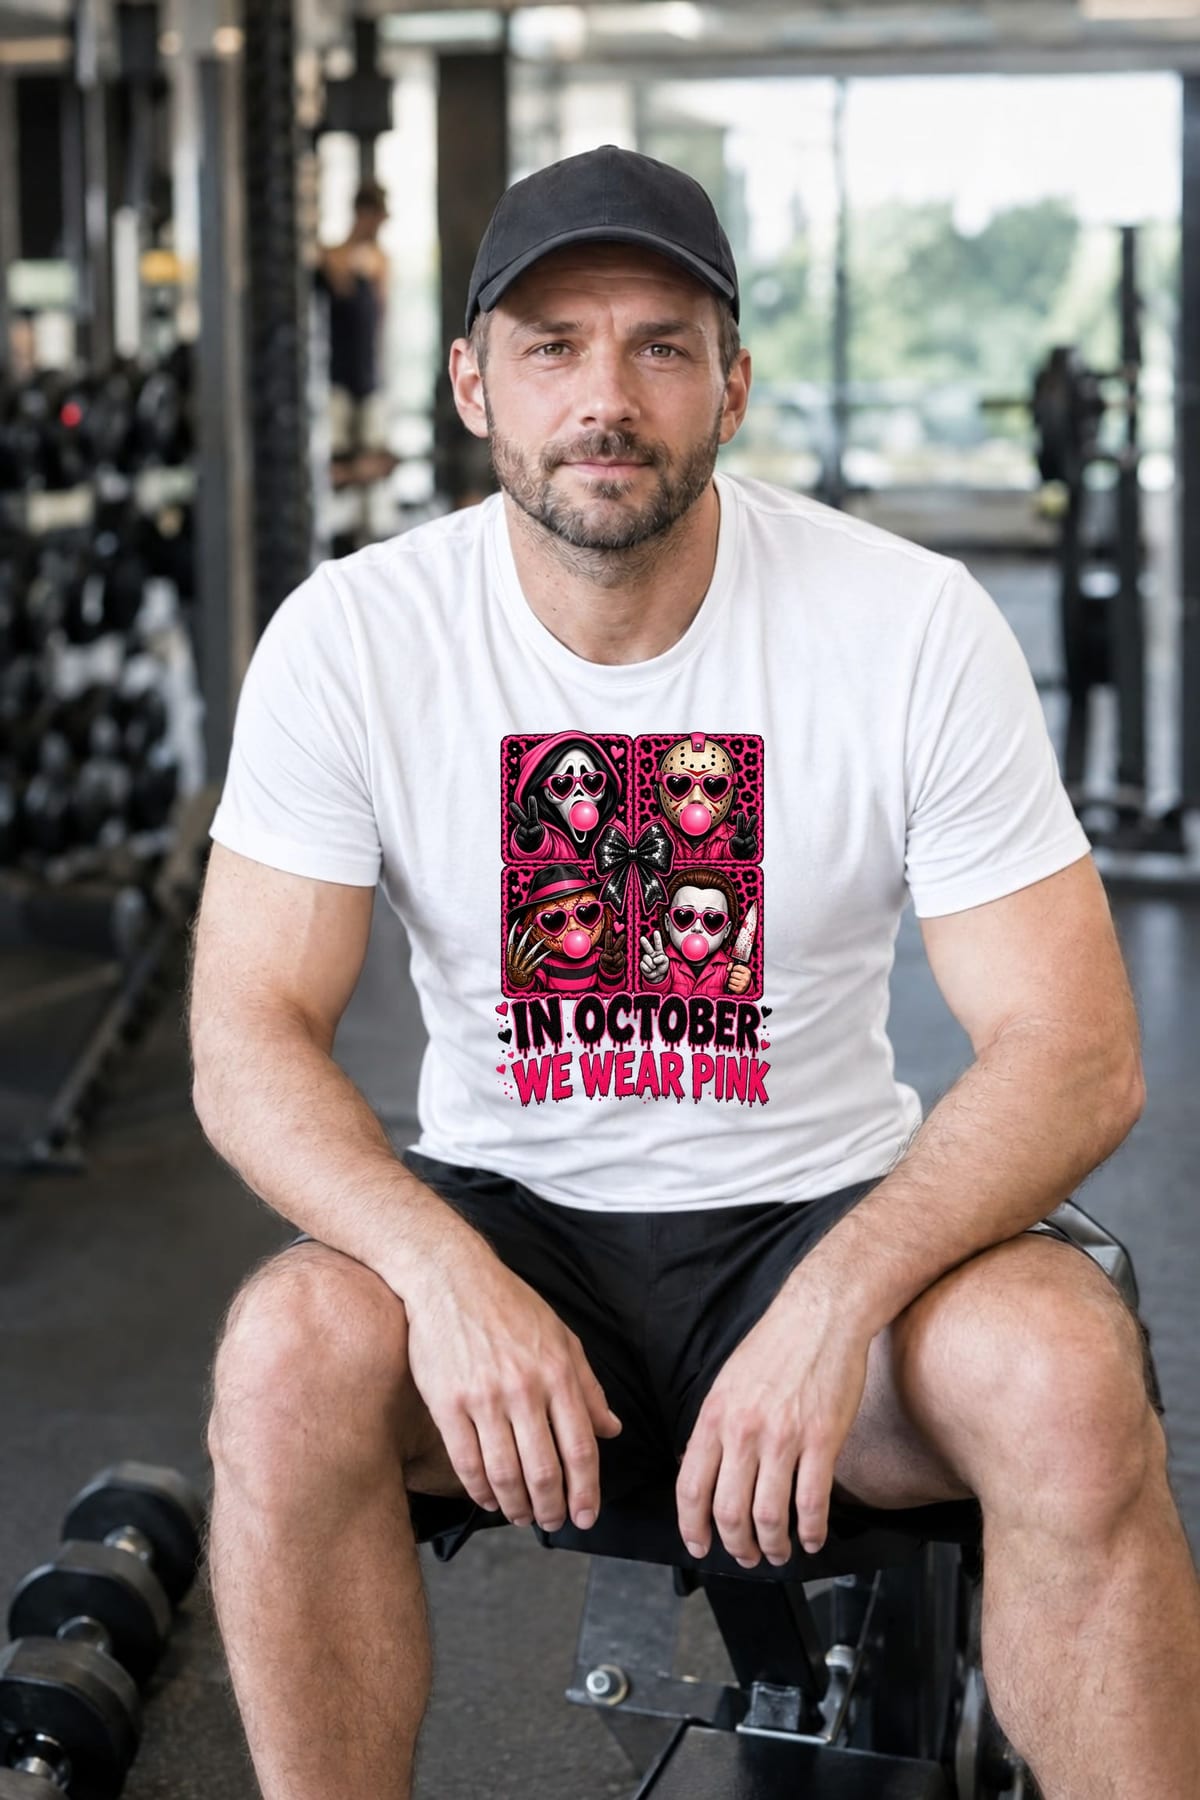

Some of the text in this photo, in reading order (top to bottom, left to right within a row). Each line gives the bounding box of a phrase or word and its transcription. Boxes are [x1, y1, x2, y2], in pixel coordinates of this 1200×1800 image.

[512, 993, 761, 1057] IN OCTOBER
[511, 1051, 771, 1106] WE WEAR PINK
